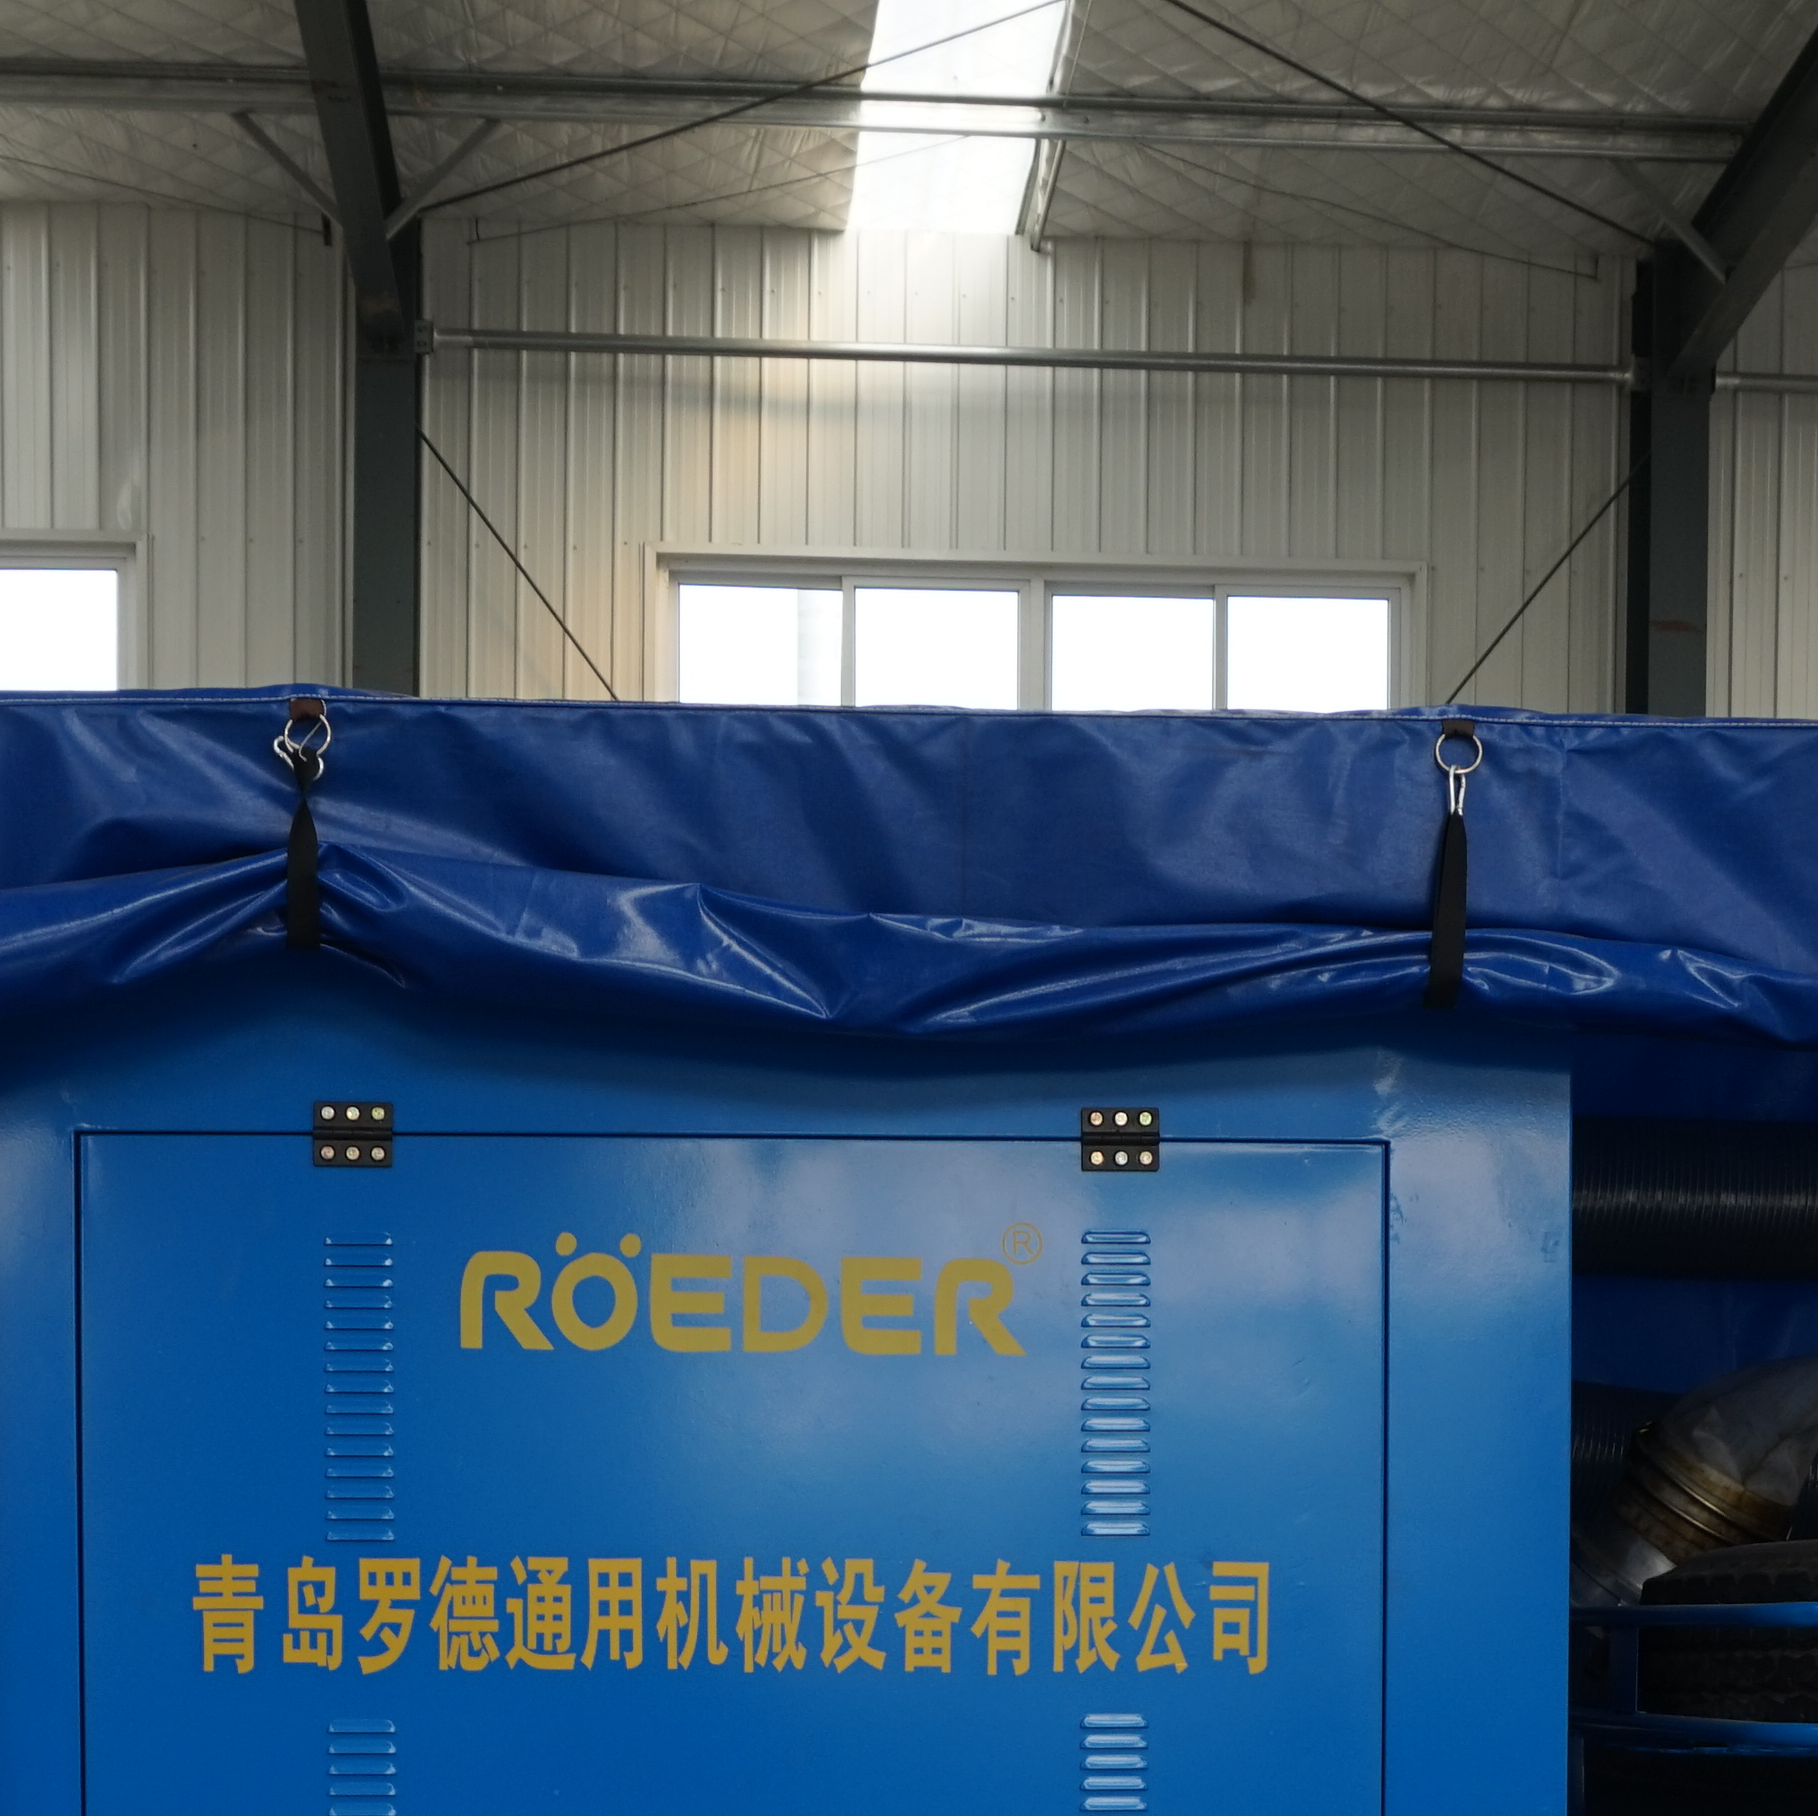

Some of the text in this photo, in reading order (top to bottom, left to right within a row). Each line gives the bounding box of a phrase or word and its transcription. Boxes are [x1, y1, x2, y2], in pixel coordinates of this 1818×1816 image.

[192, 1553, 1273, 1678] 青岛罗德通用机械设备有限公司
